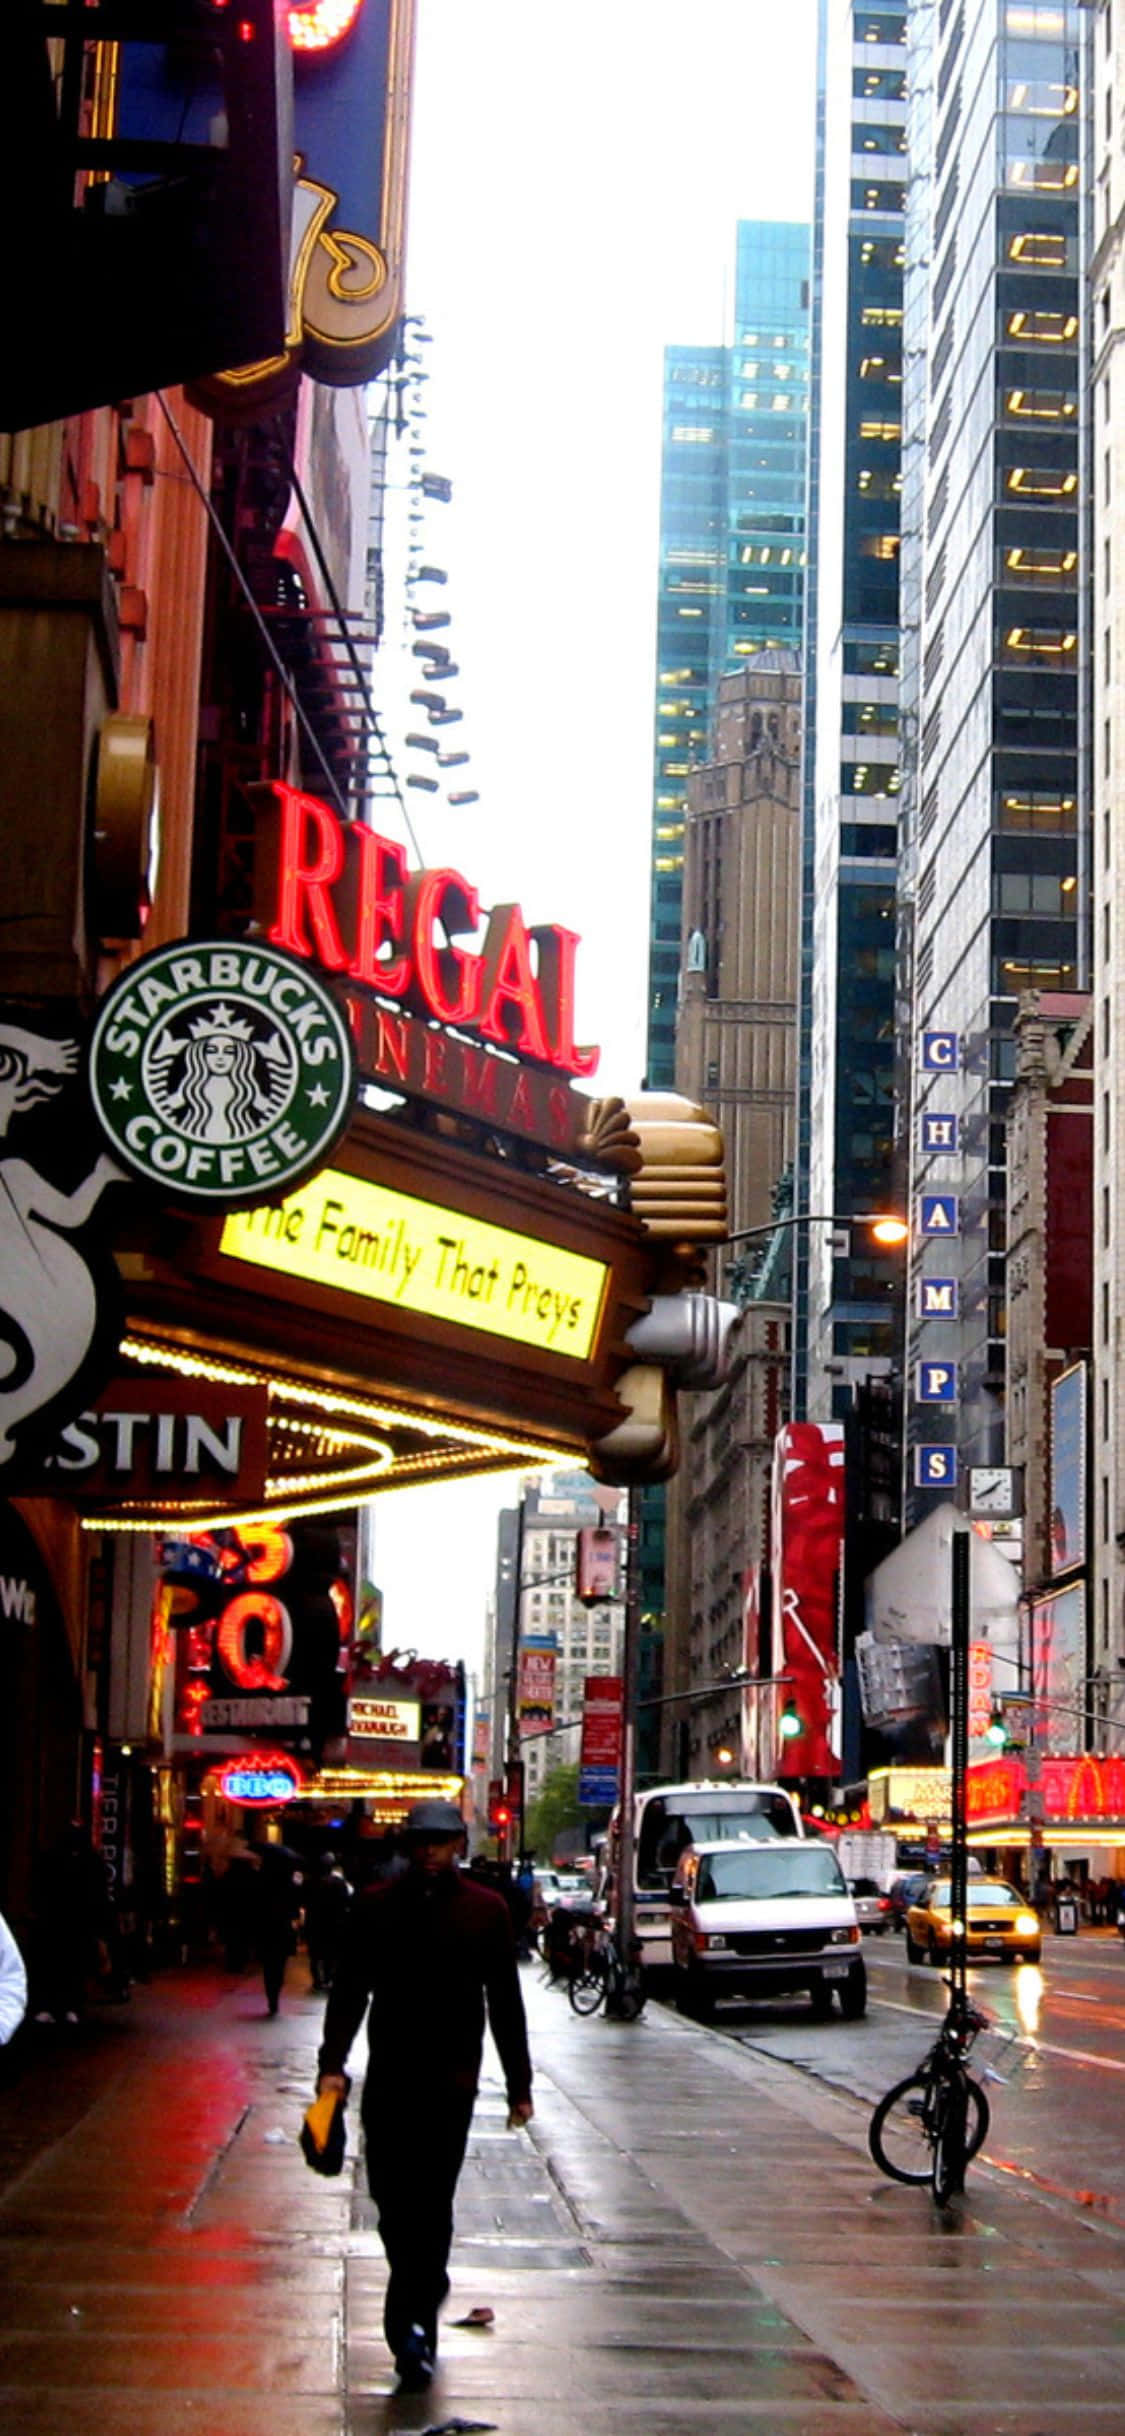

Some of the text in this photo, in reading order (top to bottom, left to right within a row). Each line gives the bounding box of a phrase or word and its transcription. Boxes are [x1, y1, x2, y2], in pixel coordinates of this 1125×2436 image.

[269, 780, 601, 1078] REGAL
[104, 953, 338, 1066] STARBUCKS
[346, 997, 571, 1144] INEMAS
[124, 1114, 308, 1183] COFFEE
[314, 1200, 423, 1298] Family
[434, 1236, 499, 1305] That
[506, 1263, 583, 1344] Preys
[924, 1037, 954, 1481] CHAMPS
[44, 1411, 242, 1474] STIN
[228, 1773, 294, 1798] BBQ
